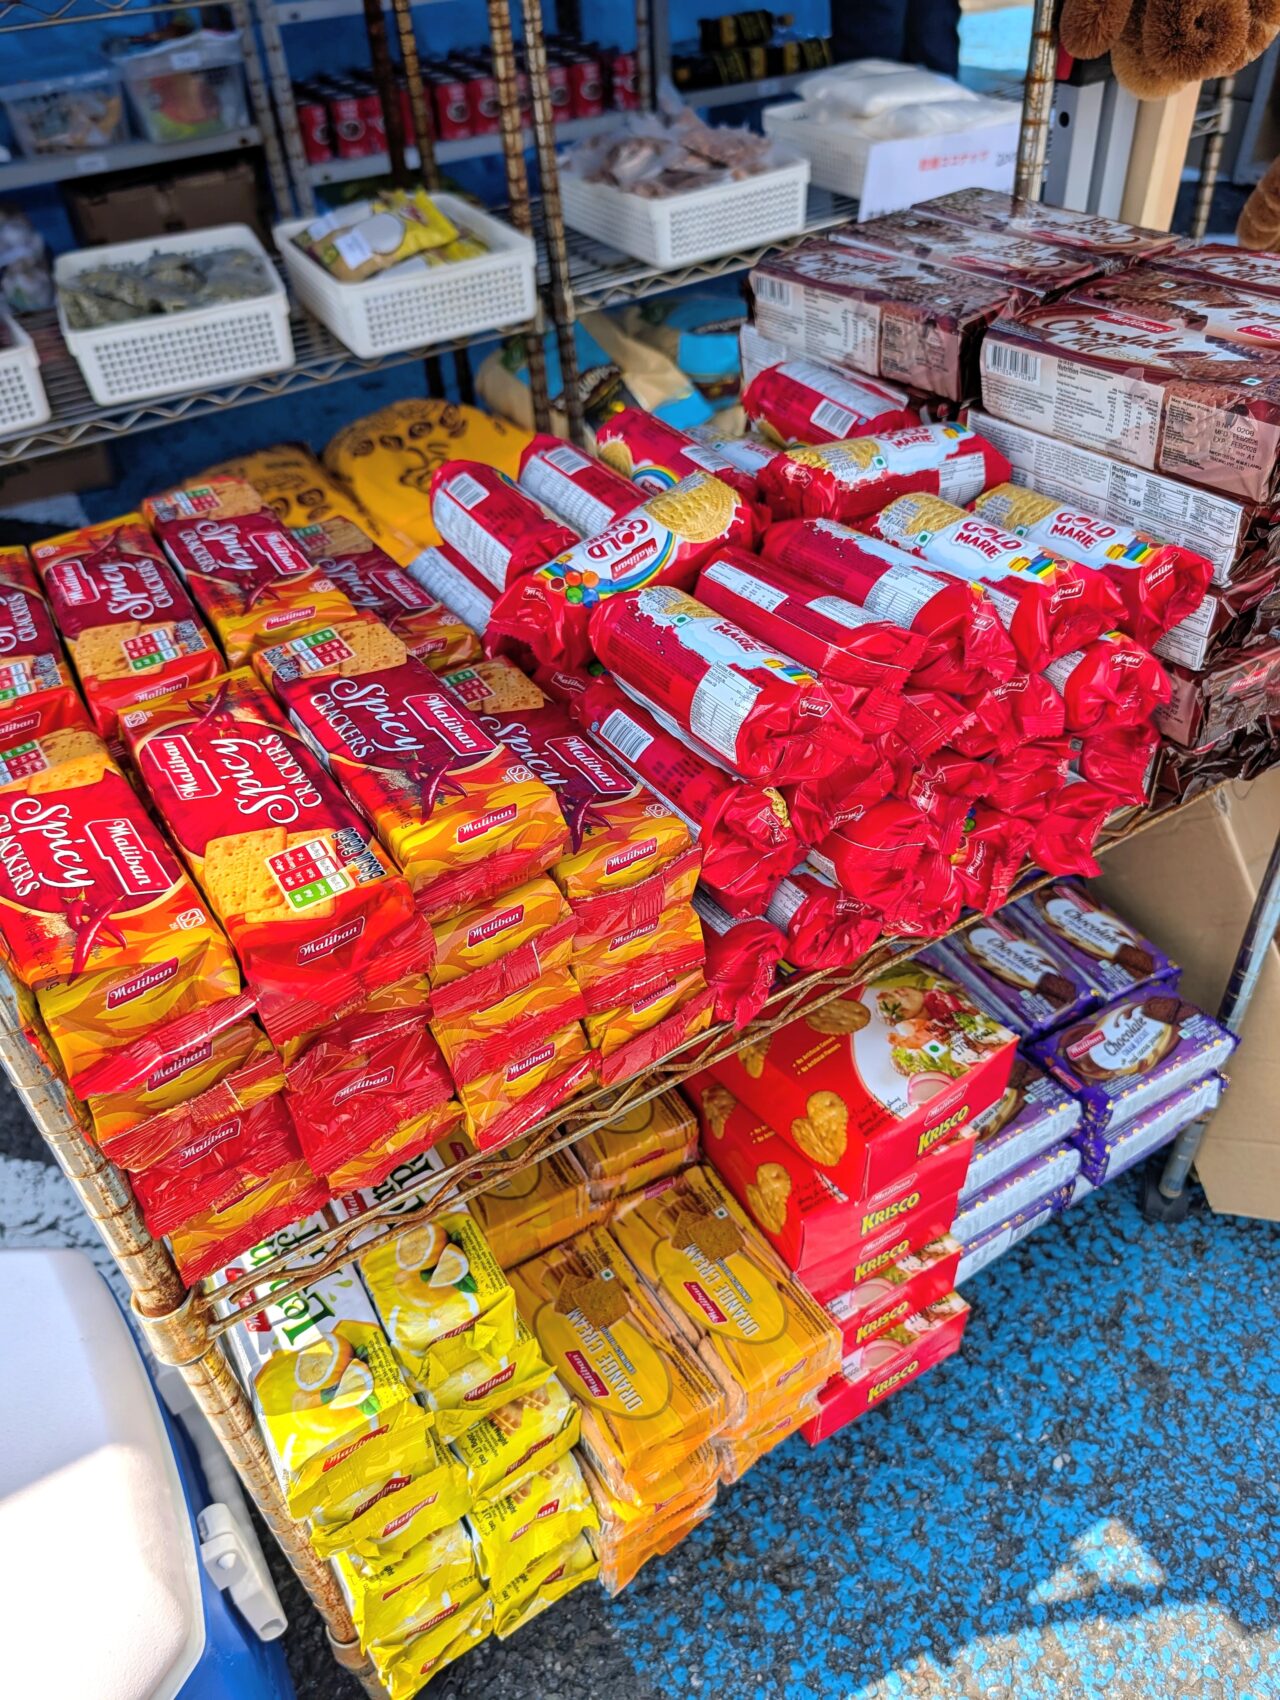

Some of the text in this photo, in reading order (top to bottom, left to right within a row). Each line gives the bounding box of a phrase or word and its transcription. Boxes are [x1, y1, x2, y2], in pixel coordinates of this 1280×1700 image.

[1042, 319, 1184, 350] Chocolate
[891, 434, 935, 449] MARIE
[196, 520, 258, 570] Spicy
[586, 519, 650, 560] GOLD
[961, 521, 1023, 551] GOLD
[1050, 524, 1098, 550] MARIE
[1055, 511, 1117, 539] GOLD
[178, 529, 220, 573] CRACKERS
[263, 533, 299, 570] Maliban
[613, 539, 658, 577] Maliban
[954, 532, 1001, 560] MARIE
[59, 564, 86, 605] Maliban
[99, 561, 156, 619] Spicy
[135, 560, 174, 608] CRACKERS
[385, 569, 422, 606] Maliban
[8, 592, 38, 642] CRACKERS
[269, 608, 313, 625] Maliban
[713, 624, 756, 652] MARIE
[135, 681, 183, 703] Maliban
[0, 719, 35, 735] aliban
[309, 692, 375, 759] CRACKERS
[329, 679, 425, 752] Spicy
[421, 695, 477, 749] Maliban
[163, 741, 201, 799] Maliban
[479, 715, 569, 786] Spicy
[561, 736, 620, 788] Maliban
[210, 738, 299, 824] Spicy
[258, 733, 323, 809] CRACKERS
[458, 808, 513, 835] Maliban
[0, 813, 41, 897] CRACKERS
[10, 797, 96, 888] Spicy
[105, 819, 152, 886] Maliban
[295, 851, 306, 862] Fat
[606, 844, 654, 867] Maliban
[304, 867, 317, 881] Salt
[300, 924, 359, 956] Maliban
[469, 911, 521, 940] Maliban
[612, 921, 657, 945] Maliban
[109, 964, 174, 1001] Maliban
[1103, 1016, 1147, 1057] Chocolate
[152, 1047, 208, 1082] Maliban
[507, 1049, 552, 1075] Maliban
[337, 1074, 389, 1099] Maliban
[181, 1127, 235, 1160] Maliban
[916, 1105, 970, 1157] KRISCO
[860, 1192, 921, 1237] KRISCO
[854, 1239, 910, 1283] KRISCO
[683, 1242, 760, 1336] ORANGE CREAM
[691, 1283, 720, 1323] Maliban
[855, 1301, 909, 1344] KRISCO
[566, 1307, 645, 1411] ORANGE CREAM
[572, 1353, 601, 1397] Maliban
[466, 1370, 514, 1400] Maliban
[867, 1360, 919, 1403] KRISCO
[492, 1426, 510, 1447] Weight
